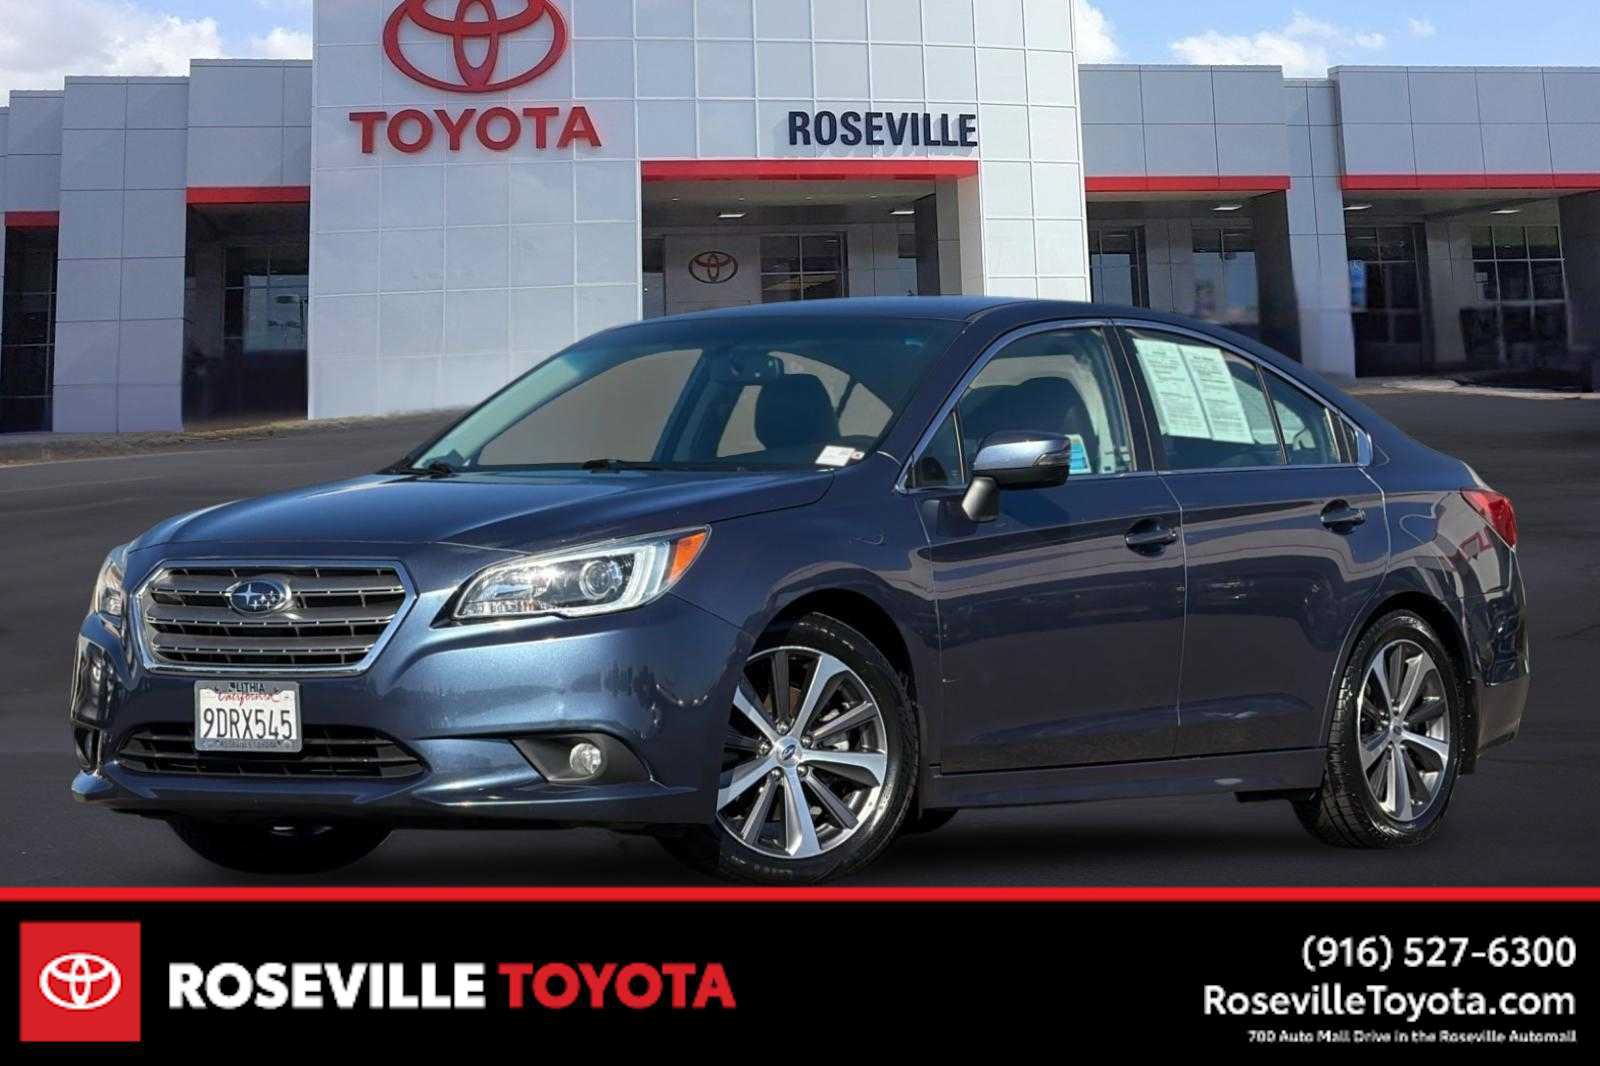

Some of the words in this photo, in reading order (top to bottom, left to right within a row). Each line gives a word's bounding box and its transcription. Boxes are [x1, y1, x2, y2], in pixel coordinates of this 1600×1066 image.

[349, 106, 602, 154] TOYOTA
[788, 110, 978, 147] ROSEVILLE
[236, 682, 265, 692] LITHIA
[203, 708, 292, 740] 9DRX545
